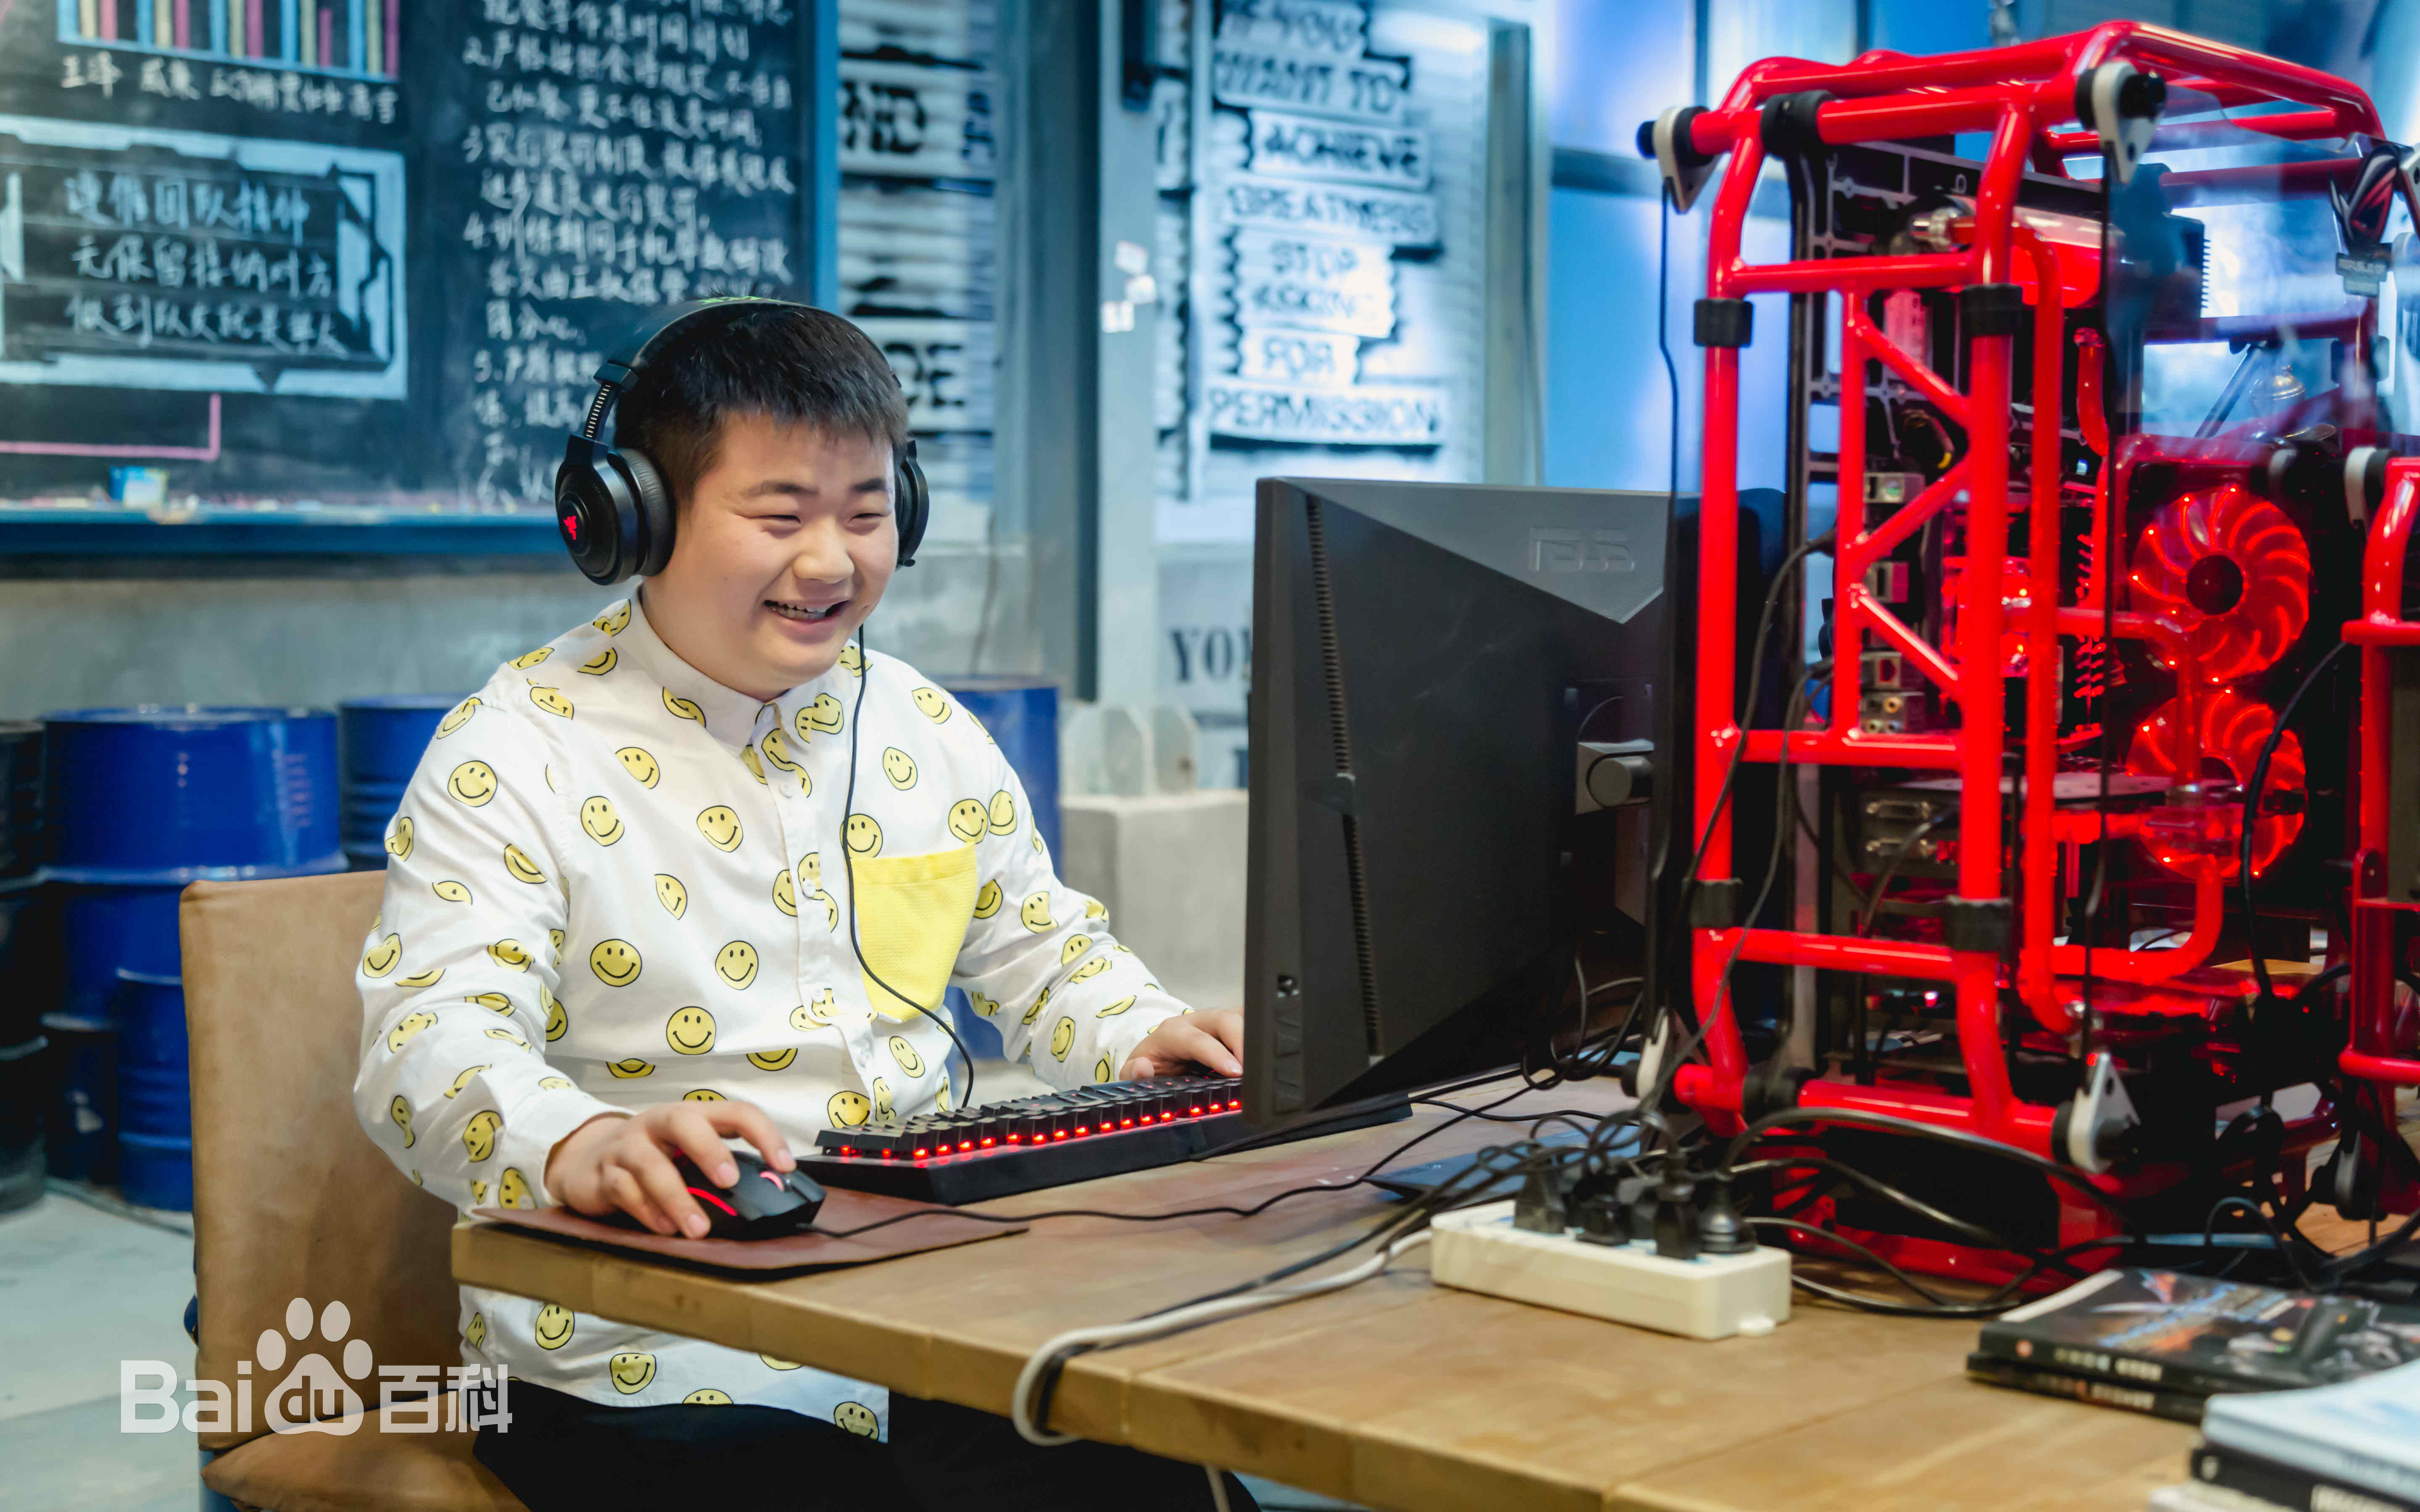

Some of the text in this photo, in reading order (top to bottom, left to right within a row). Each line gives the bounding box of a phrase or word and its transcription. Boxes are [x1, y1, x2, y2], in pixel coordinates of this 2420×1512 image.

[1349, 69, 1402, 113] TO
[1264, 335, 1336, 376] FOR
[1207, 386, 1440, 433] PERMISSION
